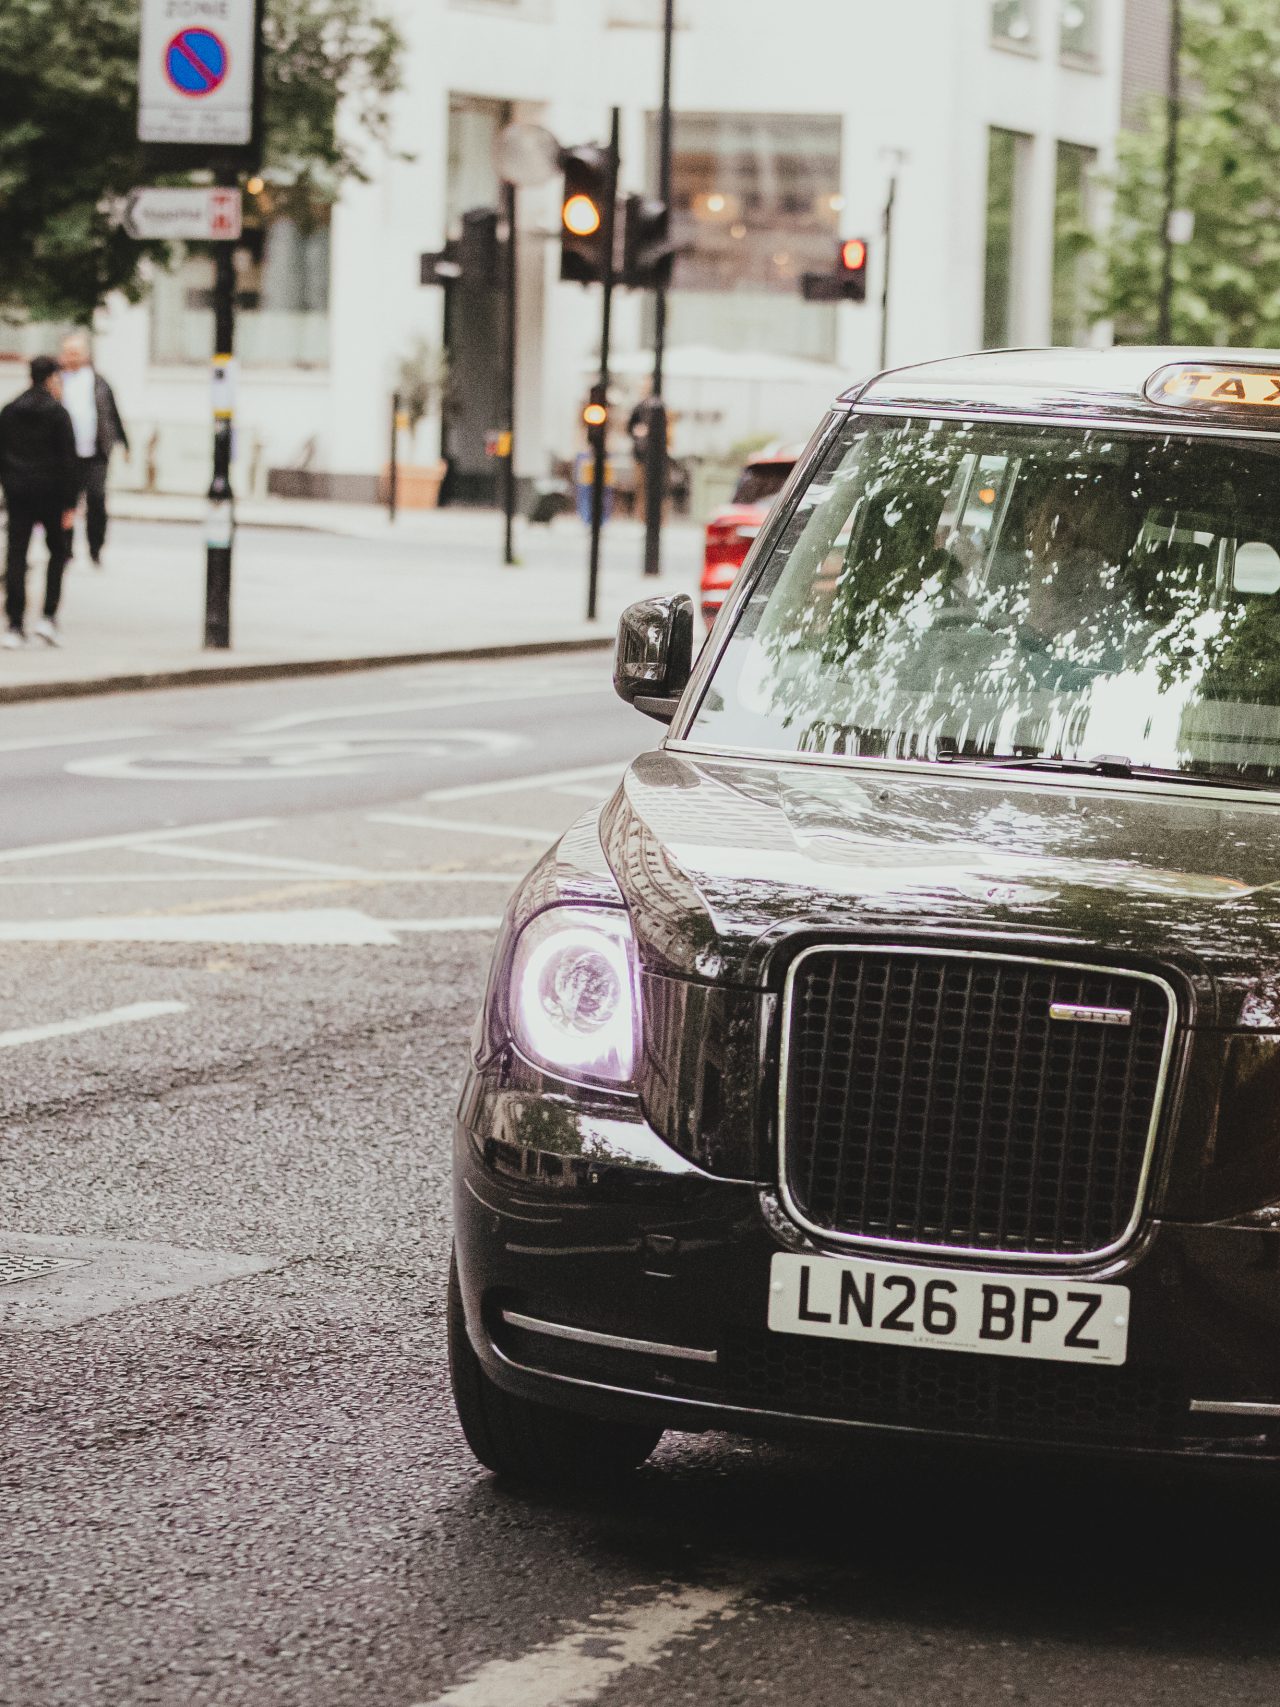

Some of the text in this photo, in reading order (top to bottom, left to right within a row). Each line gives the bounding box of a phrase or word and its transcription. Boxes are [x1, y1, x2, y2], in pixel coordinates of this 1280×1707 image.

[1073, 1010, 1128, 1023] CITY
[798, 1265, 1103, 1350] LN26 BPZ
